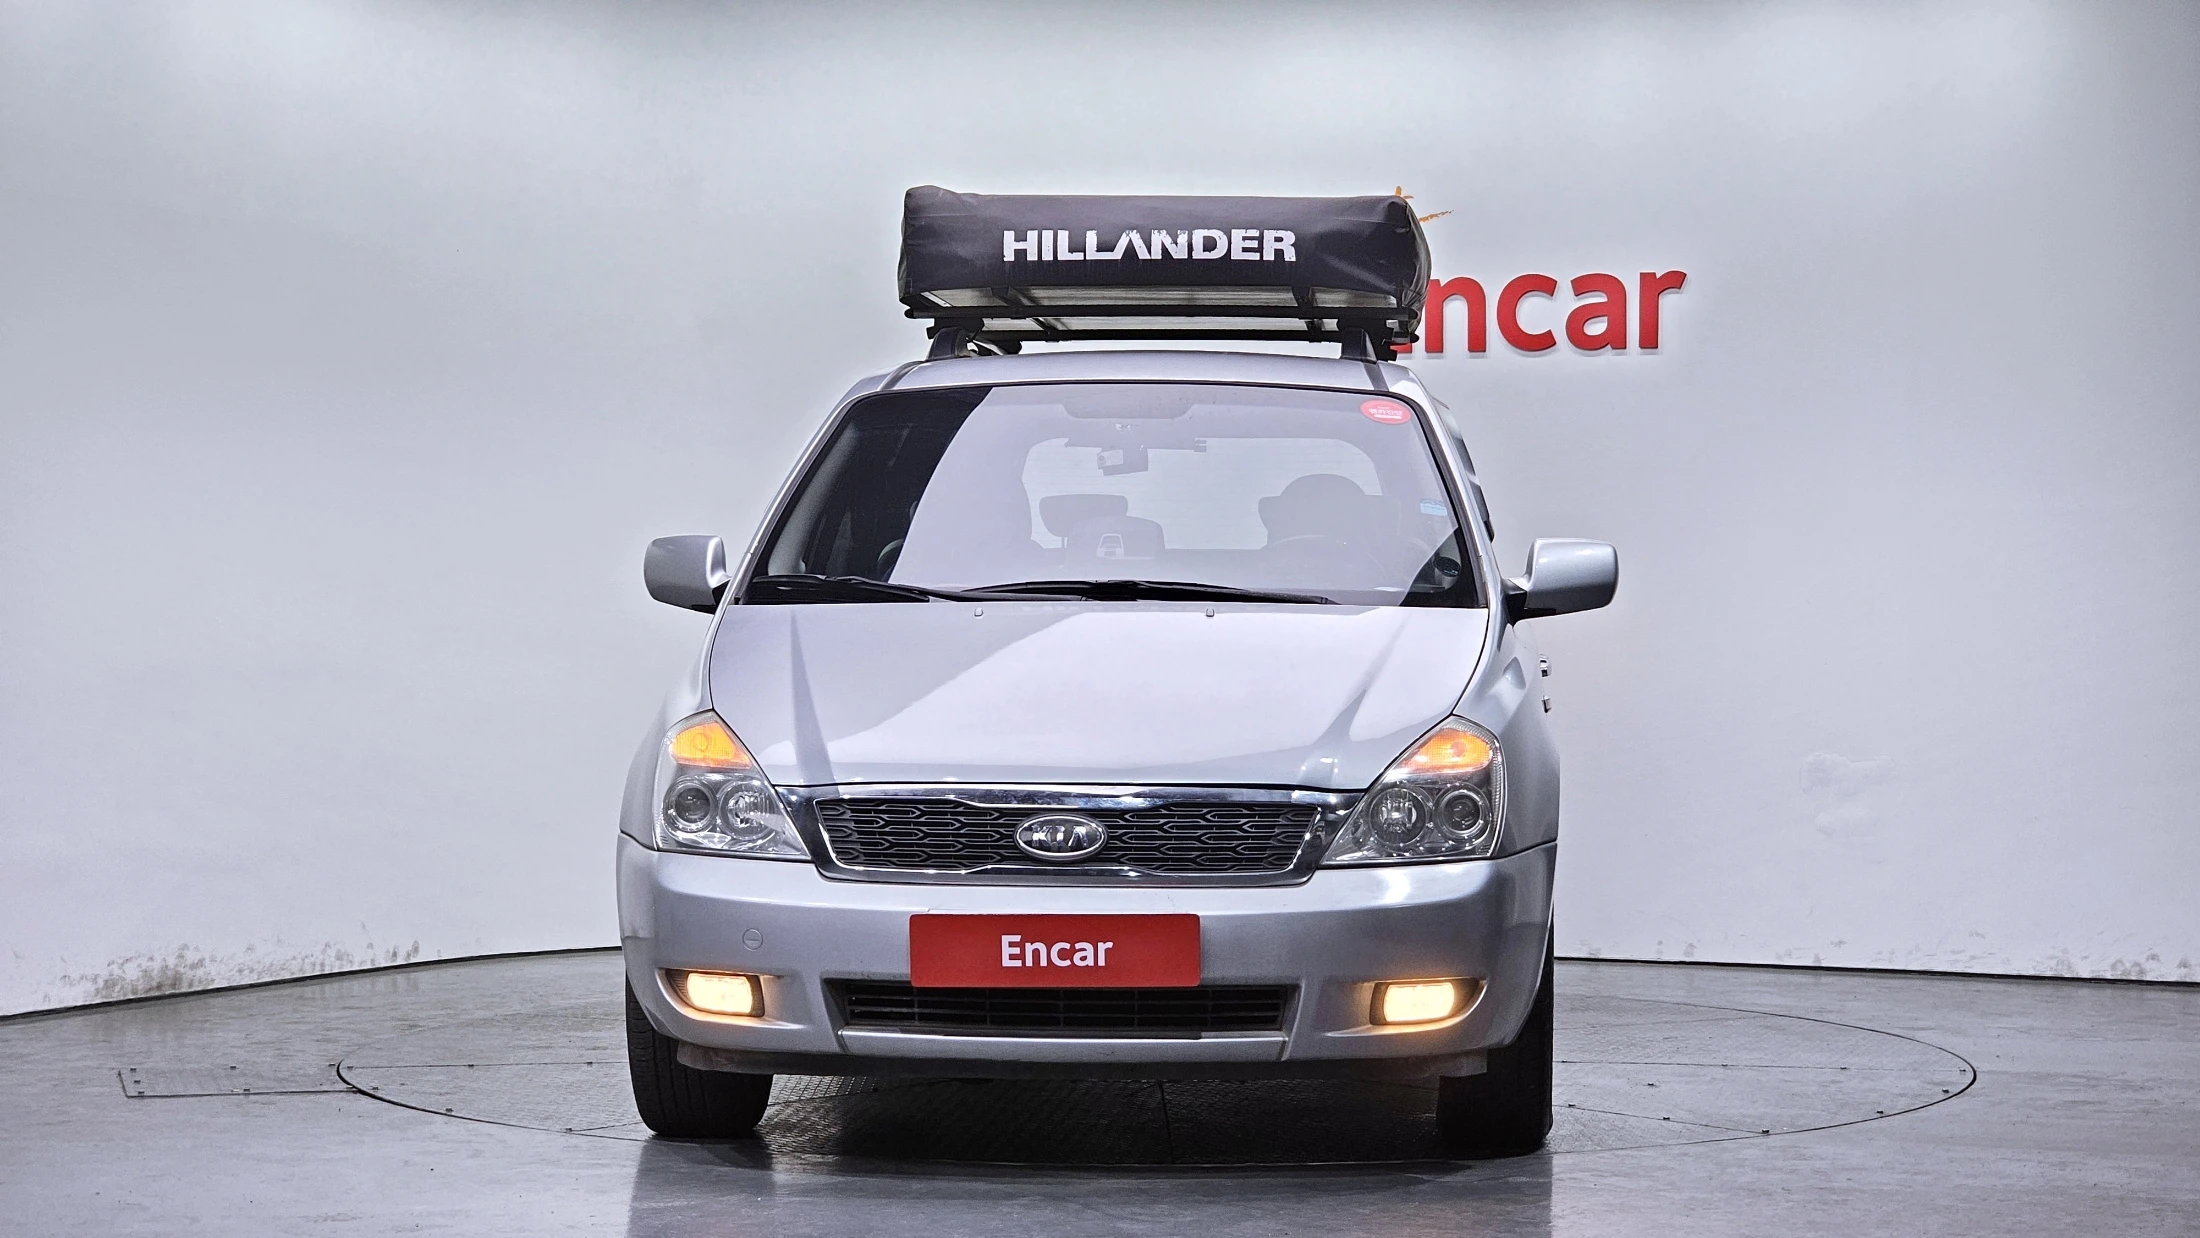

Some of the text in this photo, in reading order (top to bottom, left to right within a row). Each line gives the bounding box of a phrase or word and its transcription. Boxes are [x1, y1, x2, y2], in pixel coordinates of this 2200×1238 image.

[1003, 228, 1297, 262] HILLANDER
[1391, 270, 1687, 353] ncar
[1031, 825, 1089, 847] KIA
[1001, 934, 1114, 967] Encar
